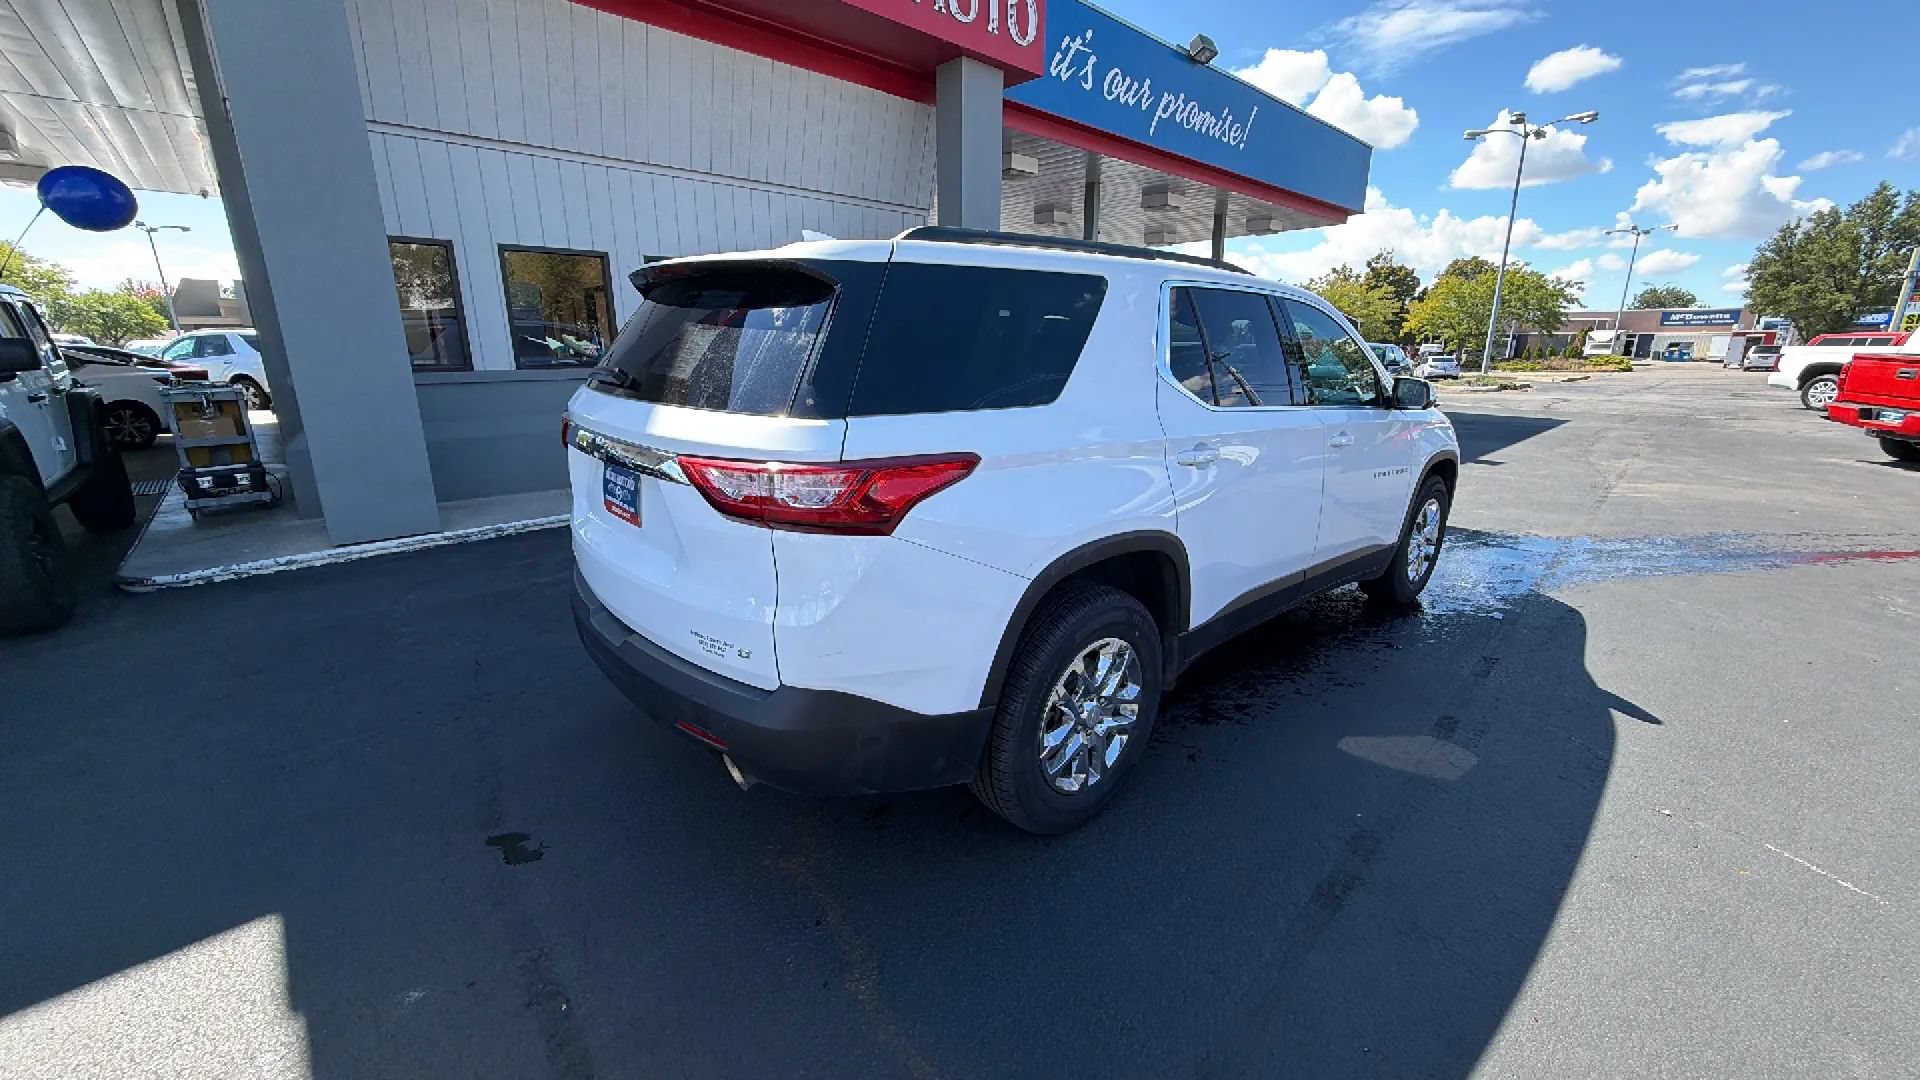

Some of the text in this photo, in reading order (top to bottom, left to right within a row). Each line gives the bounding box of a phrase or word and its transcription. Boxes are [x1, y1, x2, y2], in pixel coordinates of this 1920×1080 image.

[1050, 29, 1258, 151] it's our promise!
